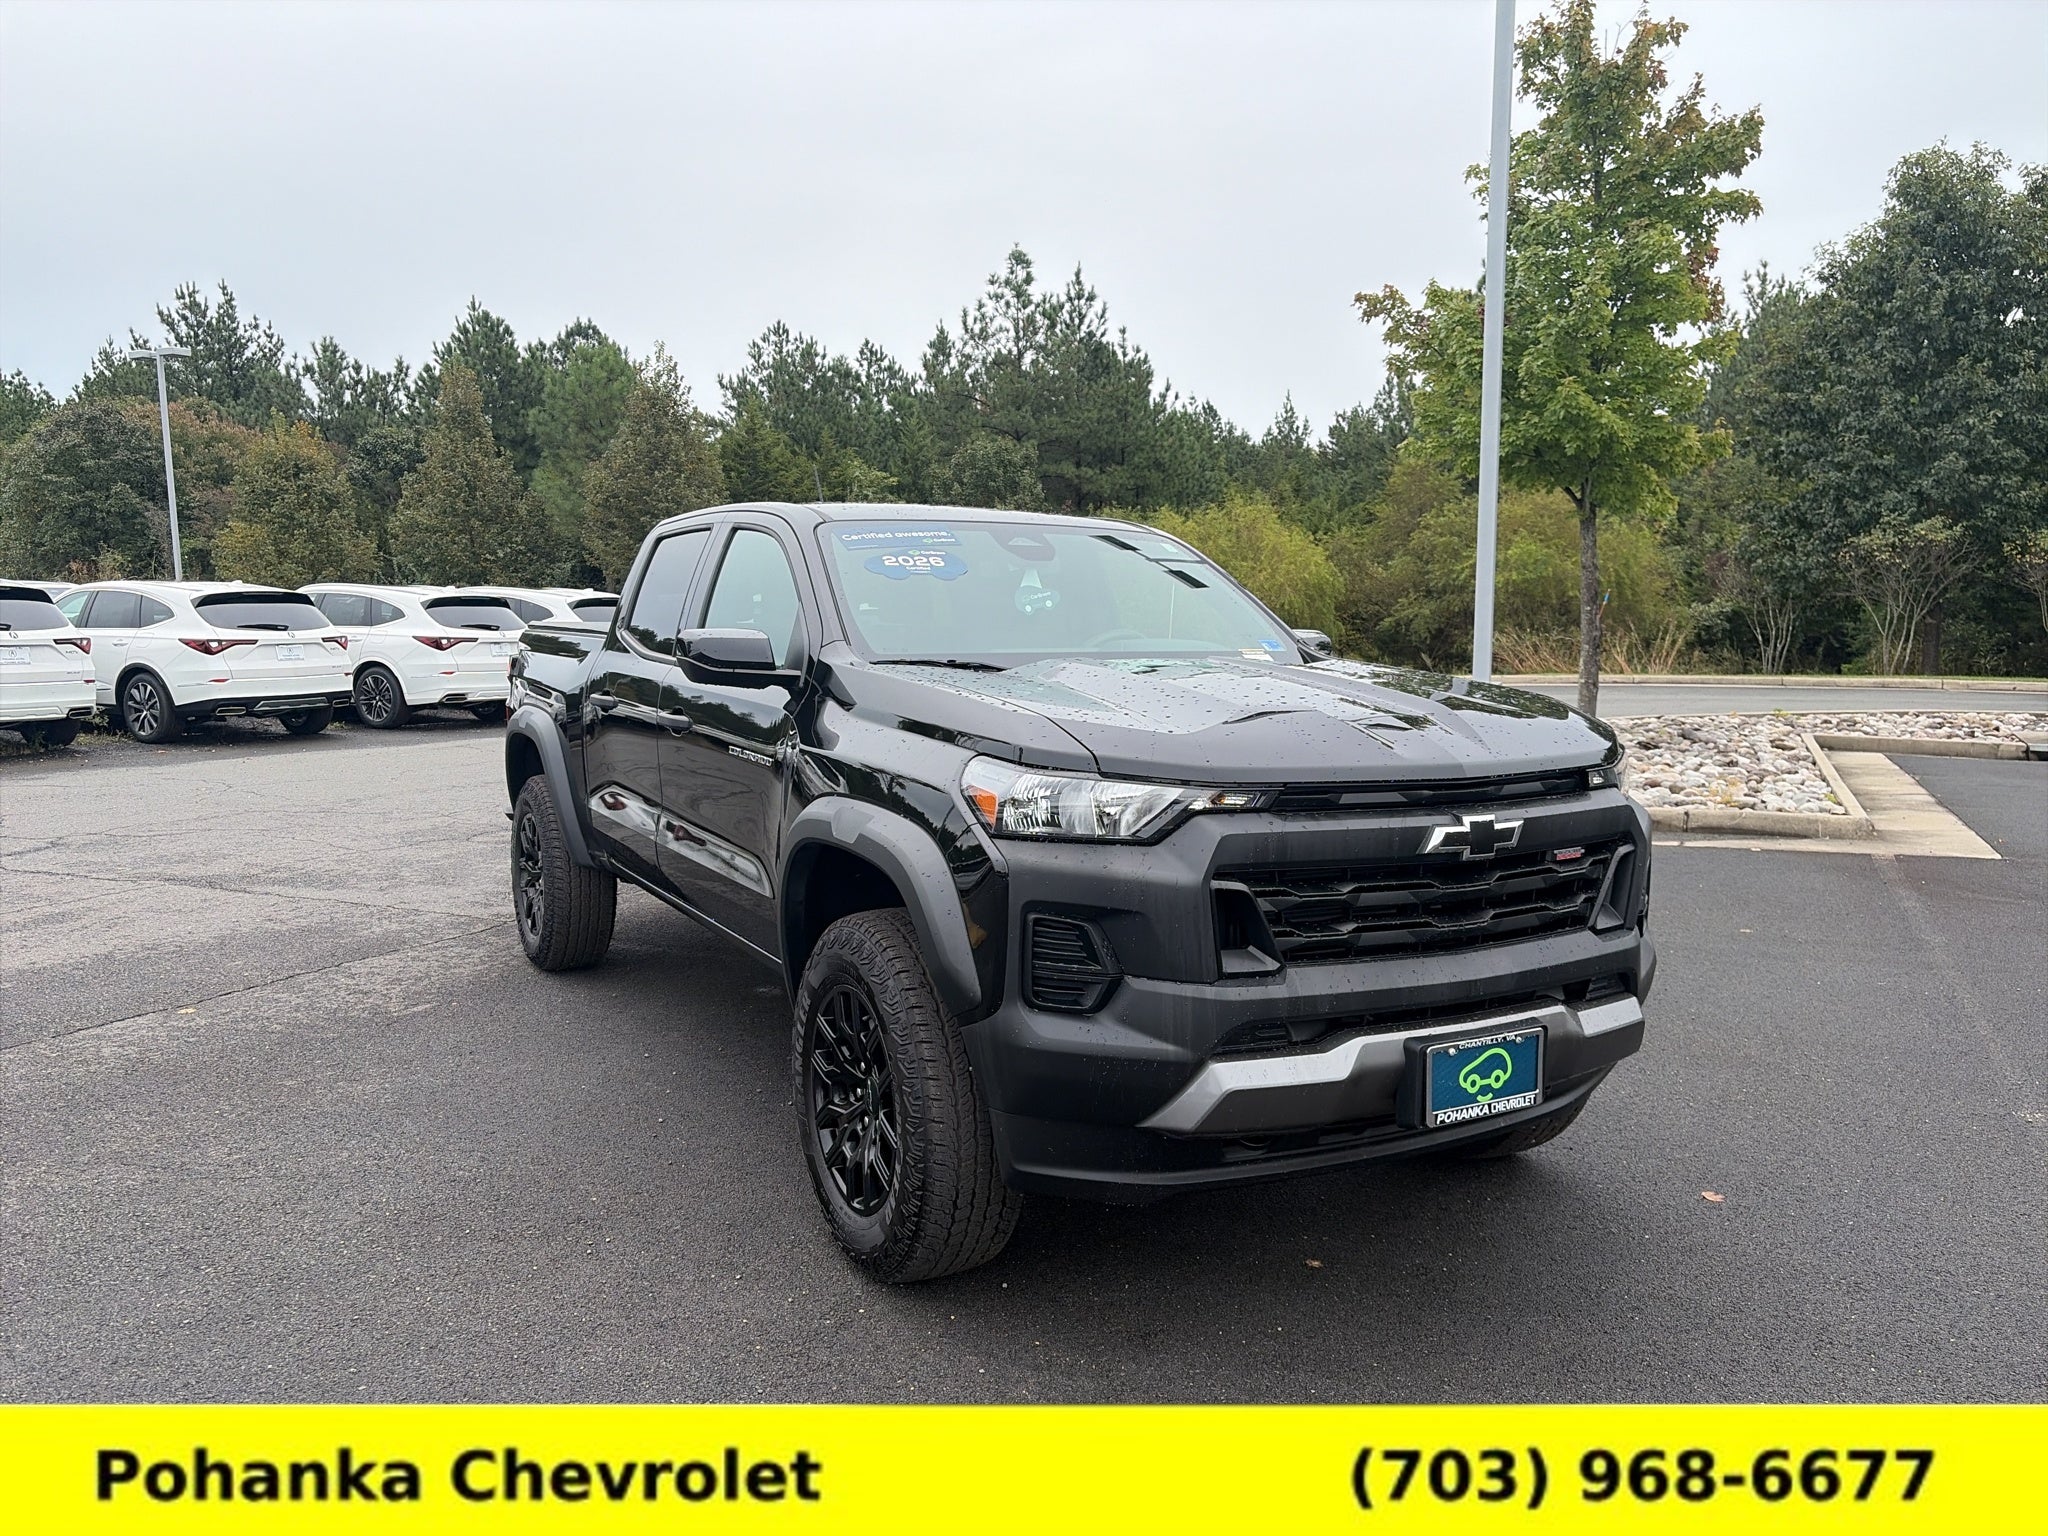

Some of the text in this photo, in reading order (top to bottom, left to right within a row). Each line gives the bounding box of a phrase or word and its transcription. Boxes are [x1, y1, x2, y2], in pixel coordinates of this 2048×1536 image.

[841, 530, 951, 541] Certified awesome.
[882, 555, 945, 567] 2026
[1505, 1034, 1516, 1043] VA
[1436, 1094, 1535, 1125] POHANKA CHEVROLET
